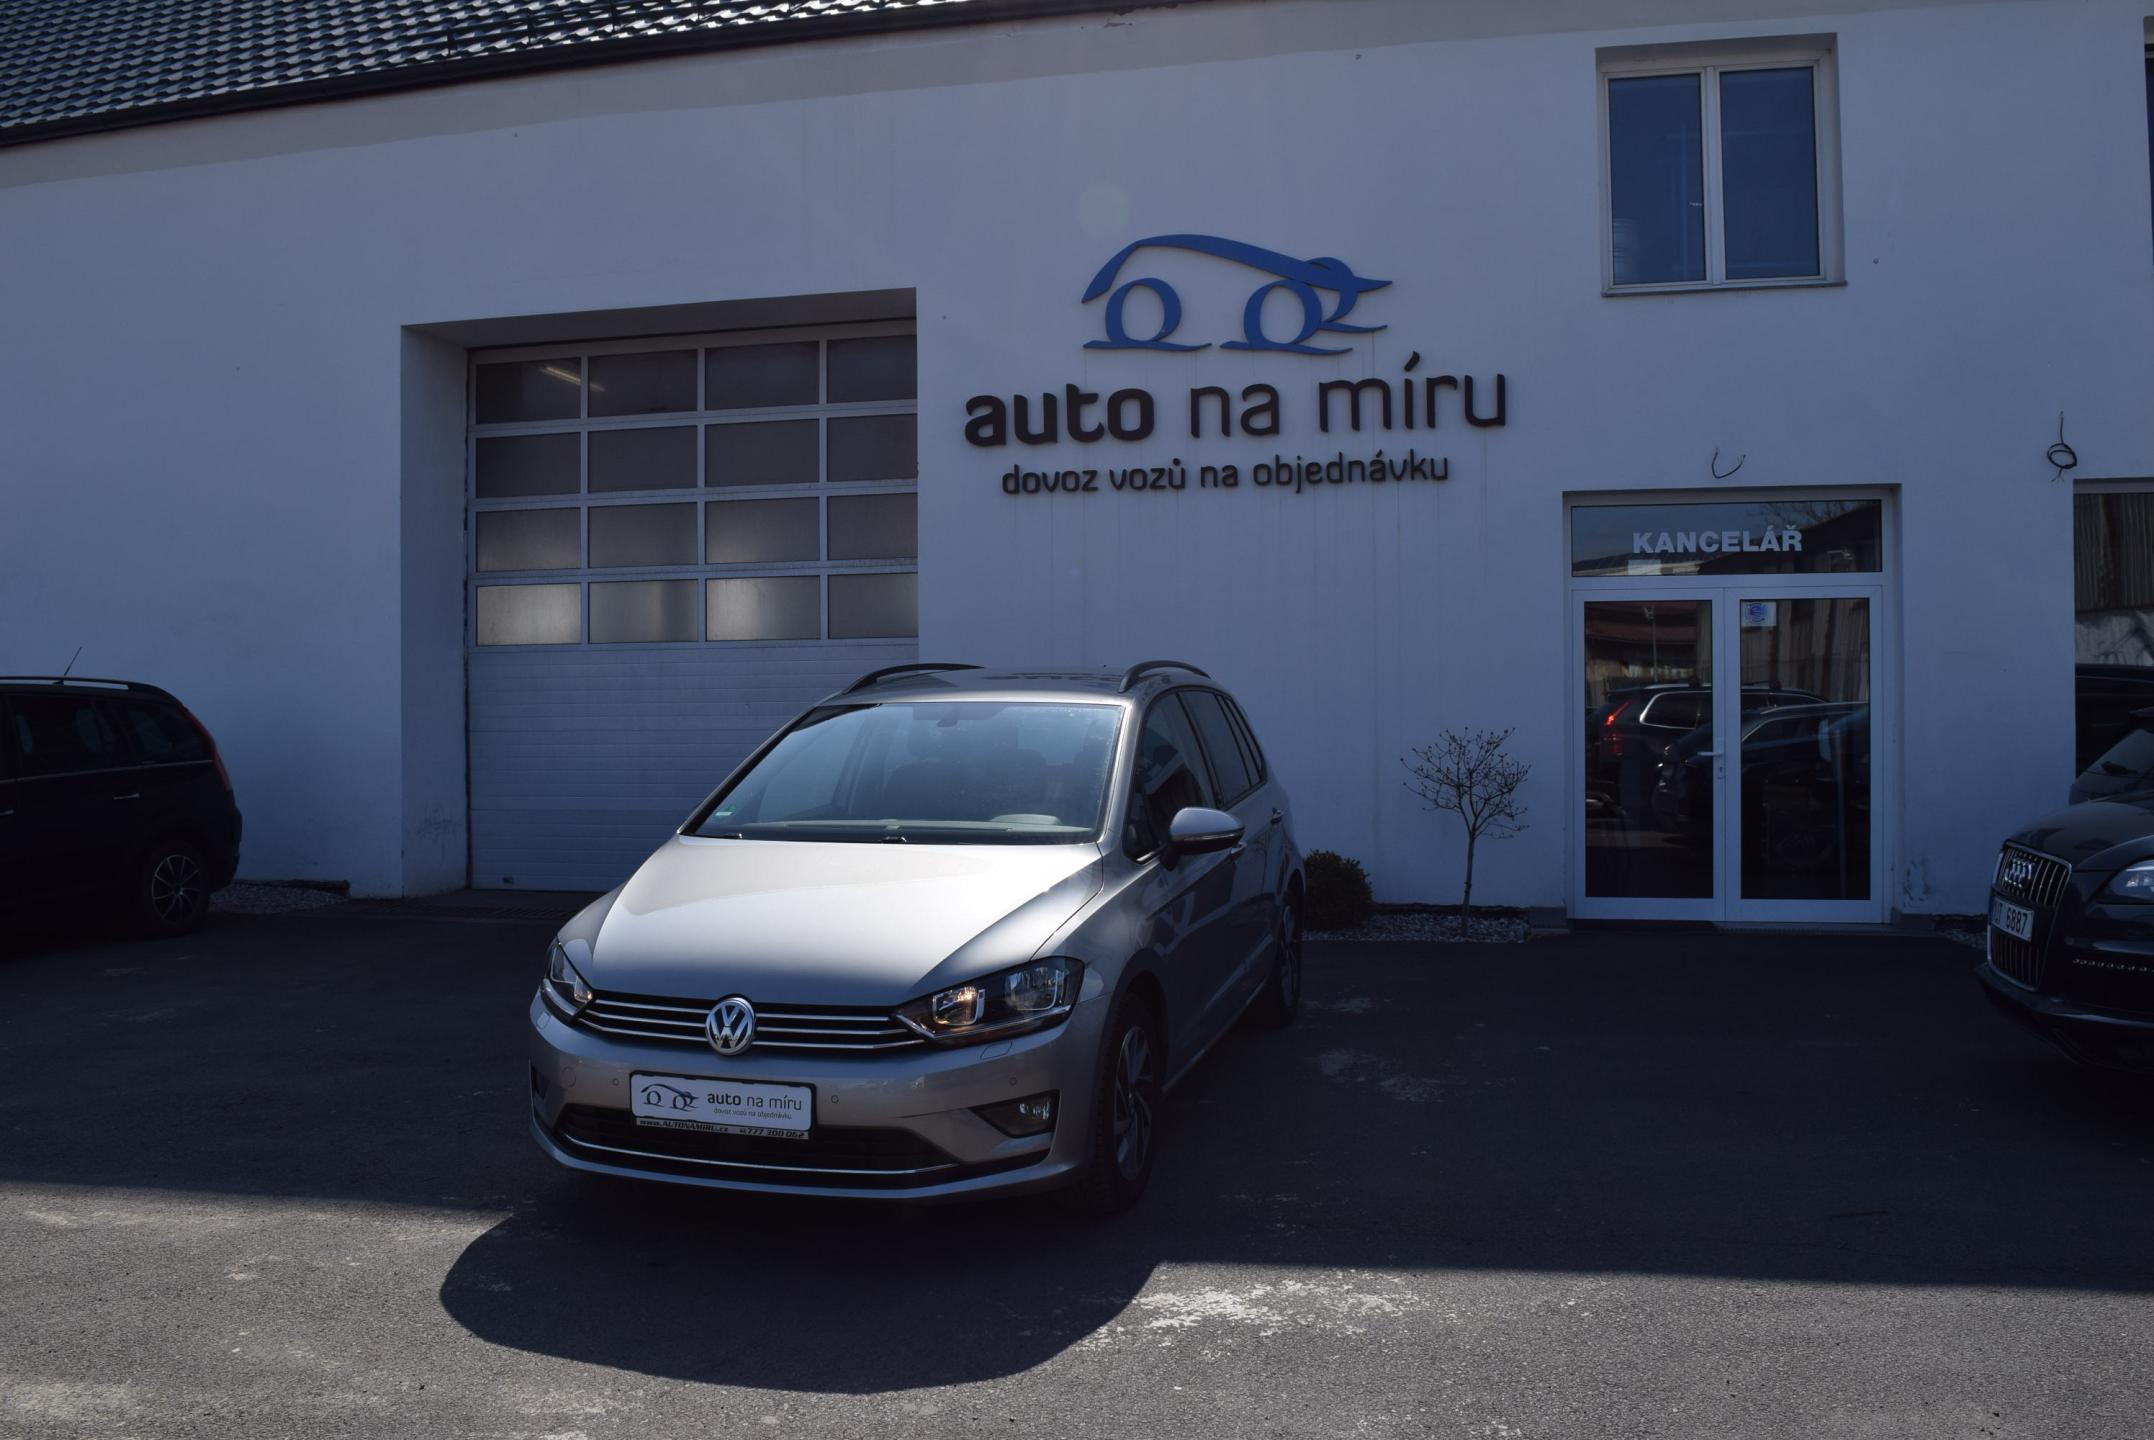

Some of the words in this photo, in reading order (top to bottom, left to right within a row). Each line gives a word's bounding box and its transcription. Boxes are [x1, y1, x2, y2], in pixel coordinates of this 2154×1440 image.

[964, 383, 1155, 447] auto
[1190, 383, 1280, 438] na
[1318, 350, 1507, 433] míru
[1001, 463, 1099, 495] dovoz
[1109, 457, 1187, 492] vozů
[1200, 464, 1240, 489] na
[1252, 448, 1449, 494] objednávku
[1633, 525, 1803, 554] KANCELÁŘ
[2006, 907, 2028, 936] 6887
[707, 1092, 742, 1106] auto
[746, 1096, 764, 1108] na
[768, 1095, 802, 1111] míru
